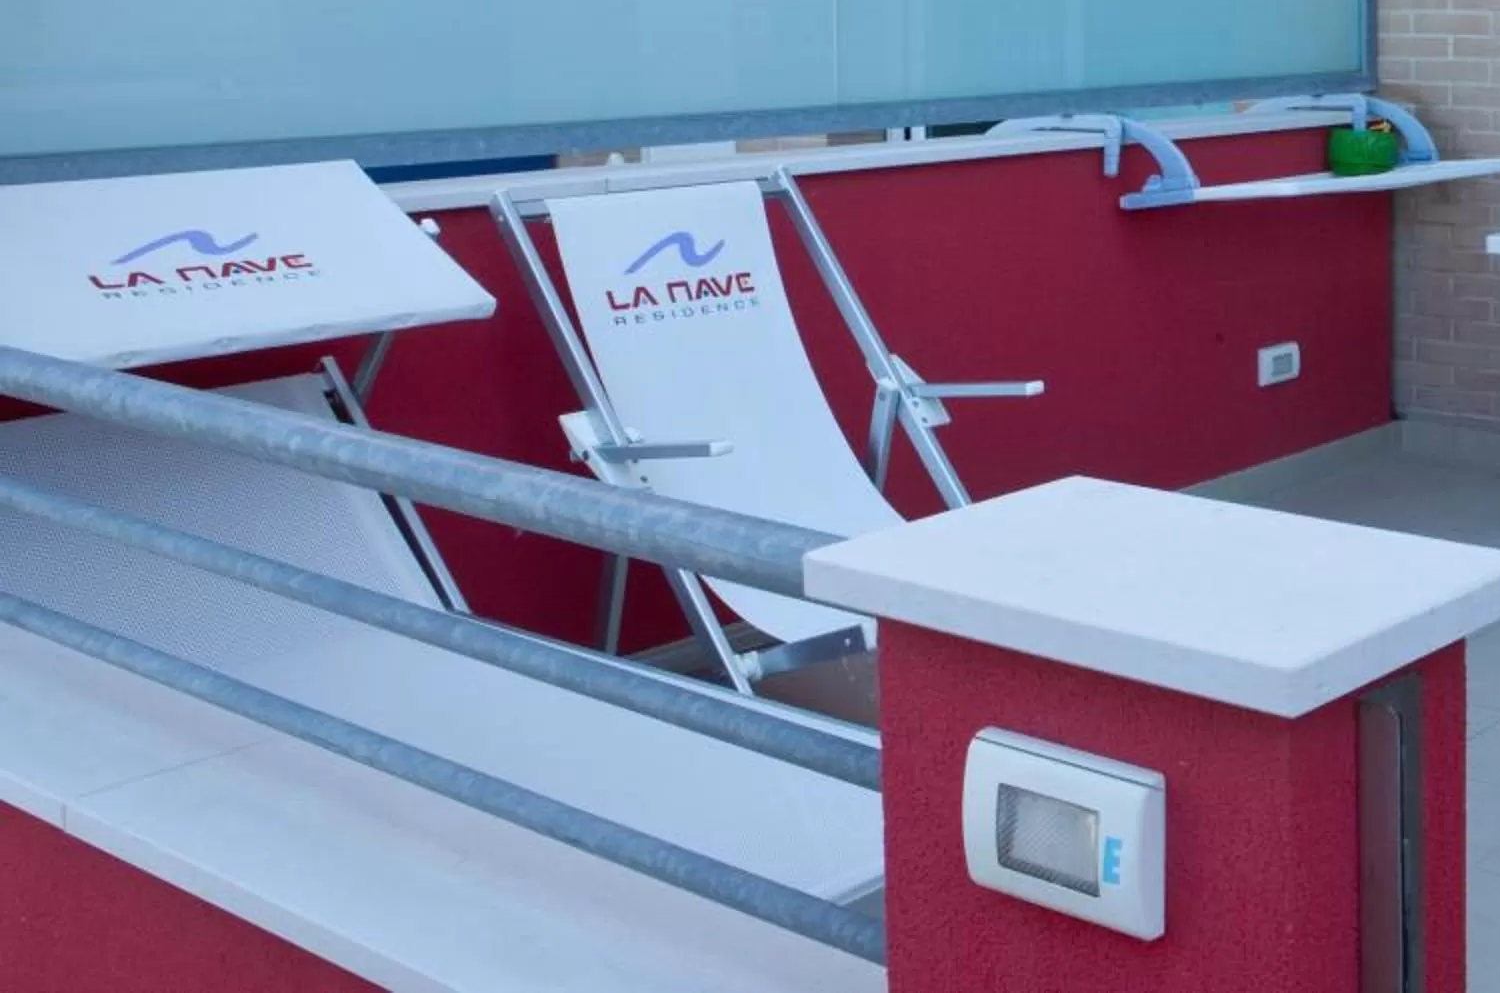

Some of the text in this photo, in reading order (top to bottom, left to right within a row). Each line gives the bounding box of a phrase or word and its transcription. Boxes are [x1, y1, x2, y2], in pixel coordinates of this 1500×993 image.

[88, 254, 313, 290] LA NAVE
[605, 272, 756, 311] LA NAVE
[613, 297, 760, 327] RESIDENCE
[1103, 836, 1122, 885] E
